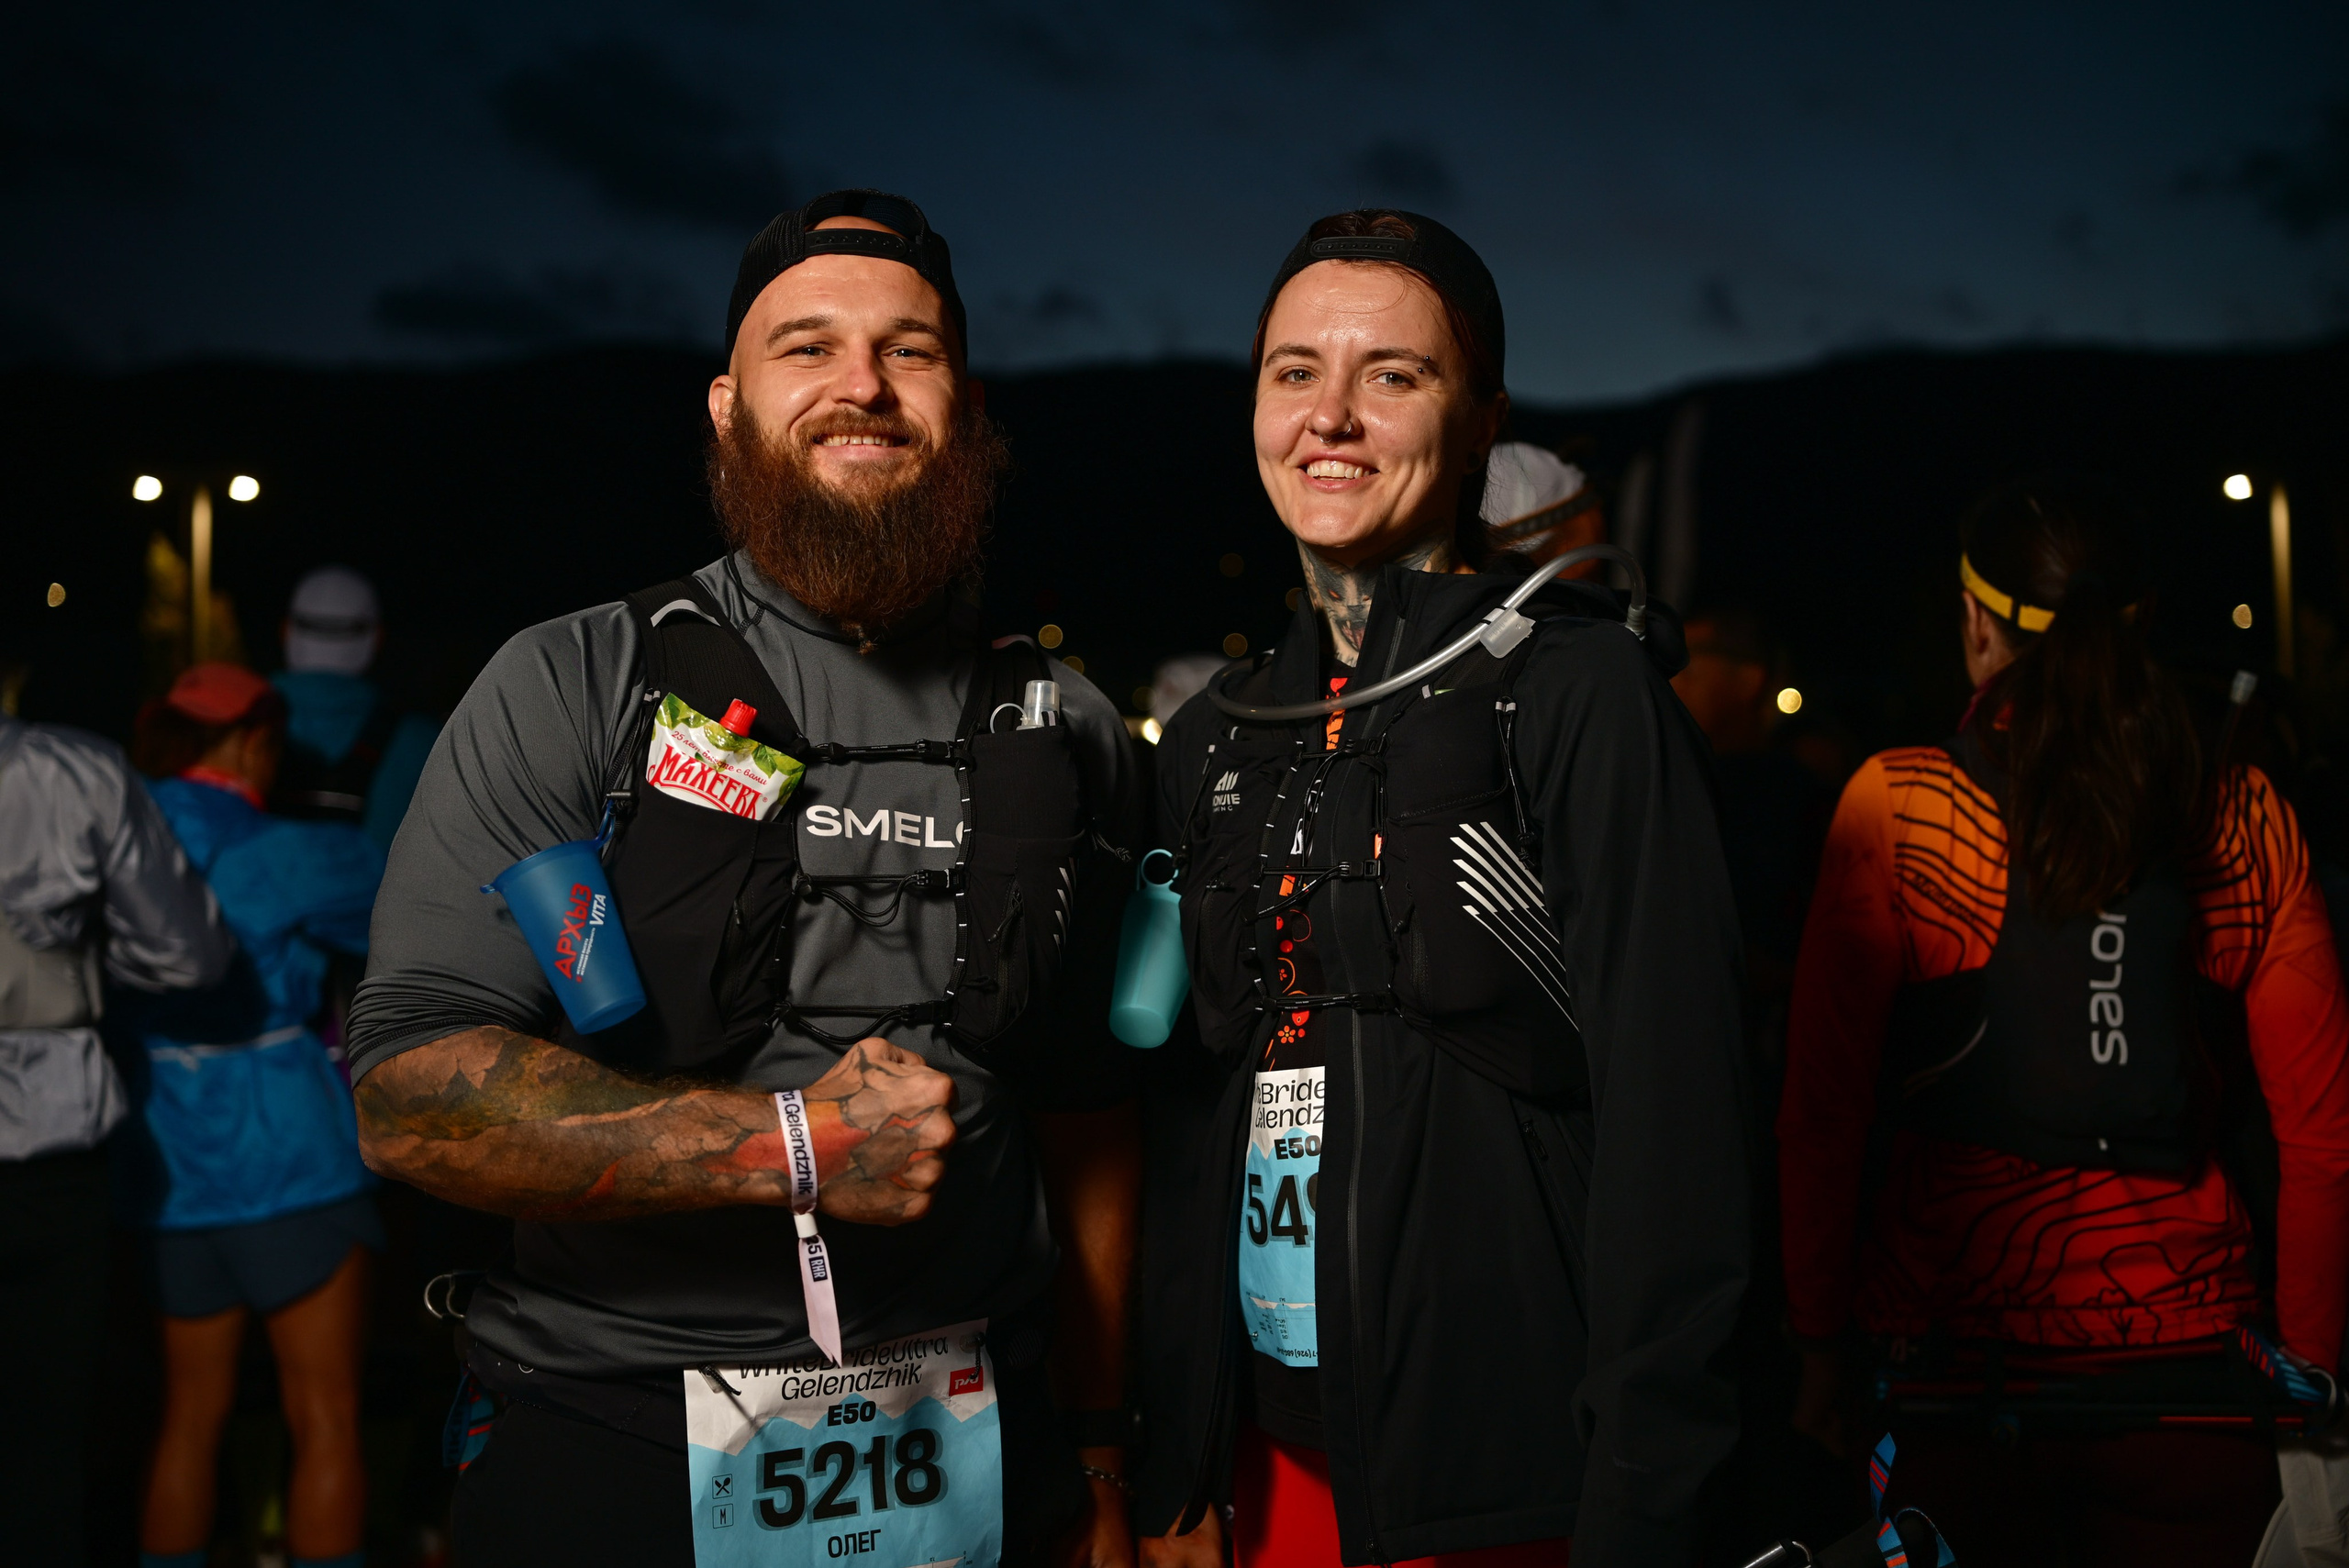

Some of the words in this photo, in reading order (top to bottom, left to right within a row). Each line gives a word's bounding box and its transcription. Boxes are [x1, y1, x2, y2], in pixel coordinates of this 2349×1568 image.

[672, 731, 685, 741] 25
[743, 769, 768, 785] вами
[806, 805, 964, 848] SMEL
[589, 894, 607, 926] VITA
[554, 883, 592, 979] АРХЫЗ
[785, 1103, 814, 1195] Gelendzhik
[1274, 1135, 1321, 1161] E50
[810, 1258, 827, 1279] RHR
[781, 1363, 923, 1400] Gelendzhik
[827, 1400, 876, 1427] E50
[755, 1428, 947, 1529] 5218
[828, 1529, 881, 1558] ОЛЕГ
